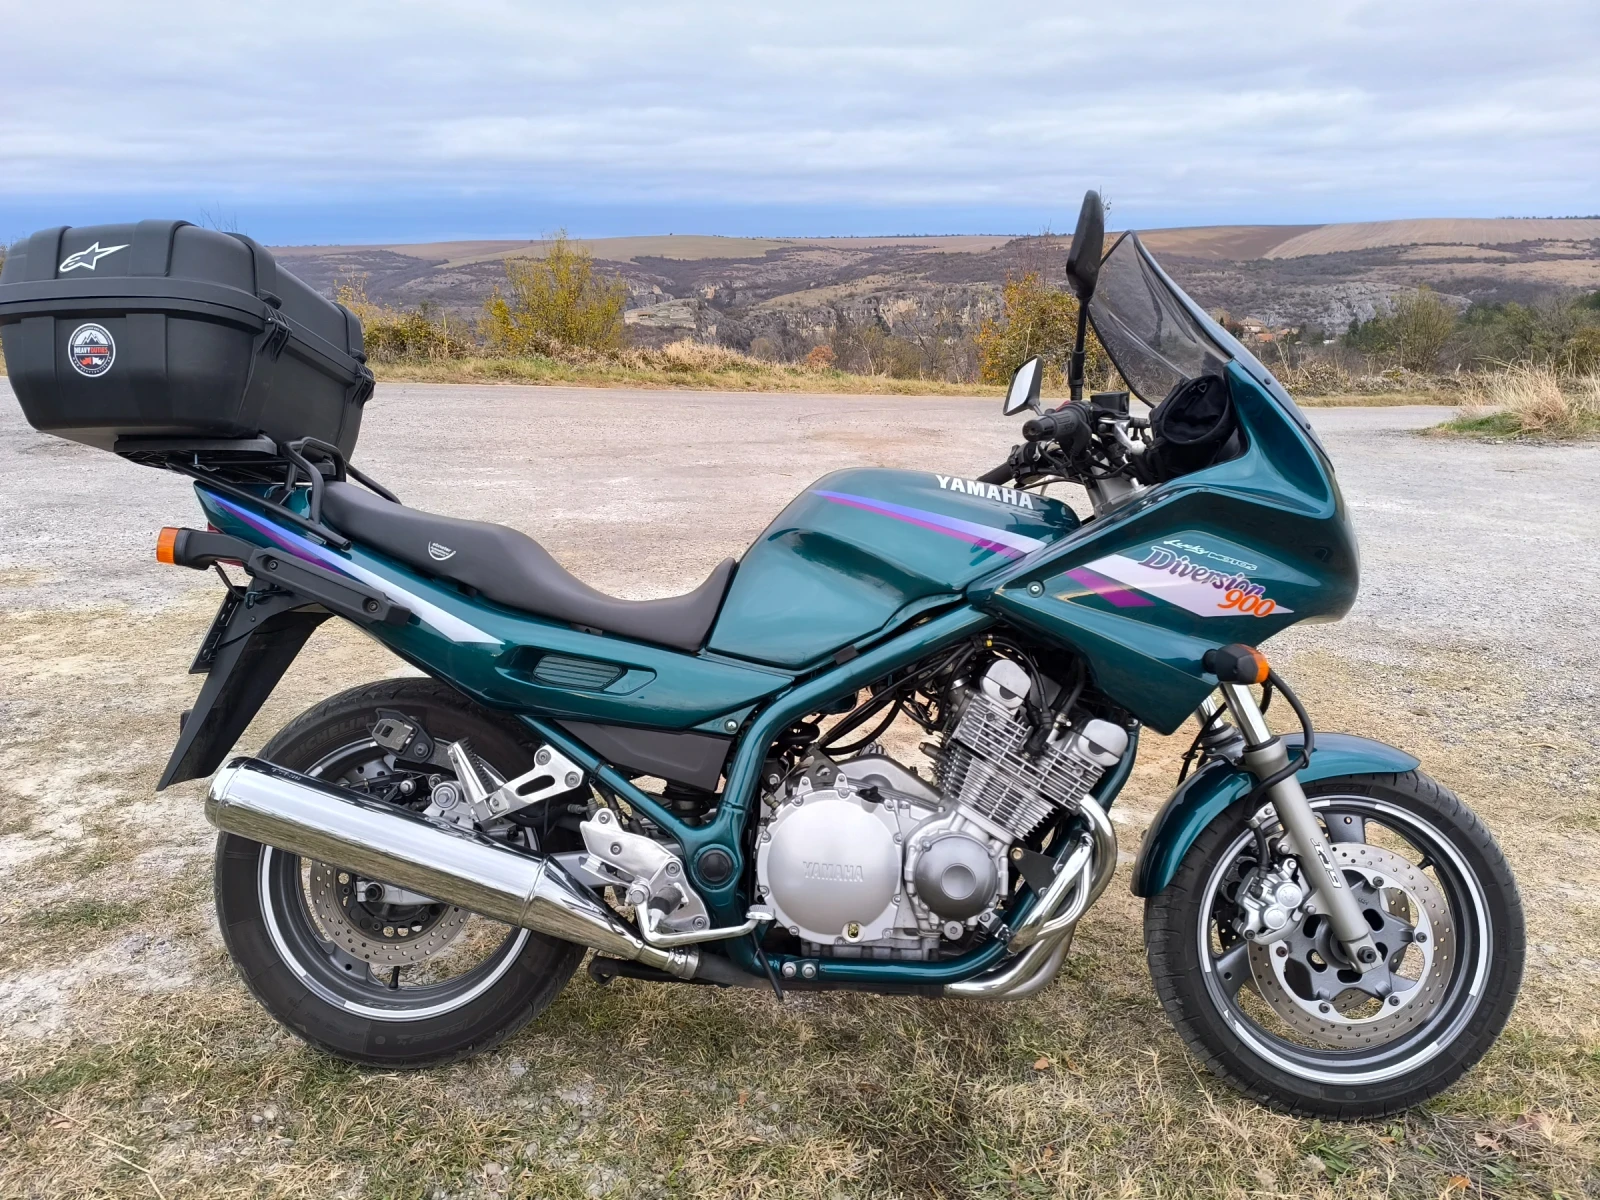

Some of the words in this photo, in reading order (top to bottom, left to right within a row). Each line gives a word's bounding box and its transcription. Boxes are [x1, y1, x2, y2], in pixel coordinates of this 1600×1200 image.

[936, 475, 1034, 510] YAMAHA
[1138, 545, 1266, 598] Diversion
[1217, 590, 1276, 617] 900
[284, 716, 371, 767] MICHELIN
[803, 861, 863, 882] YAMAHA
